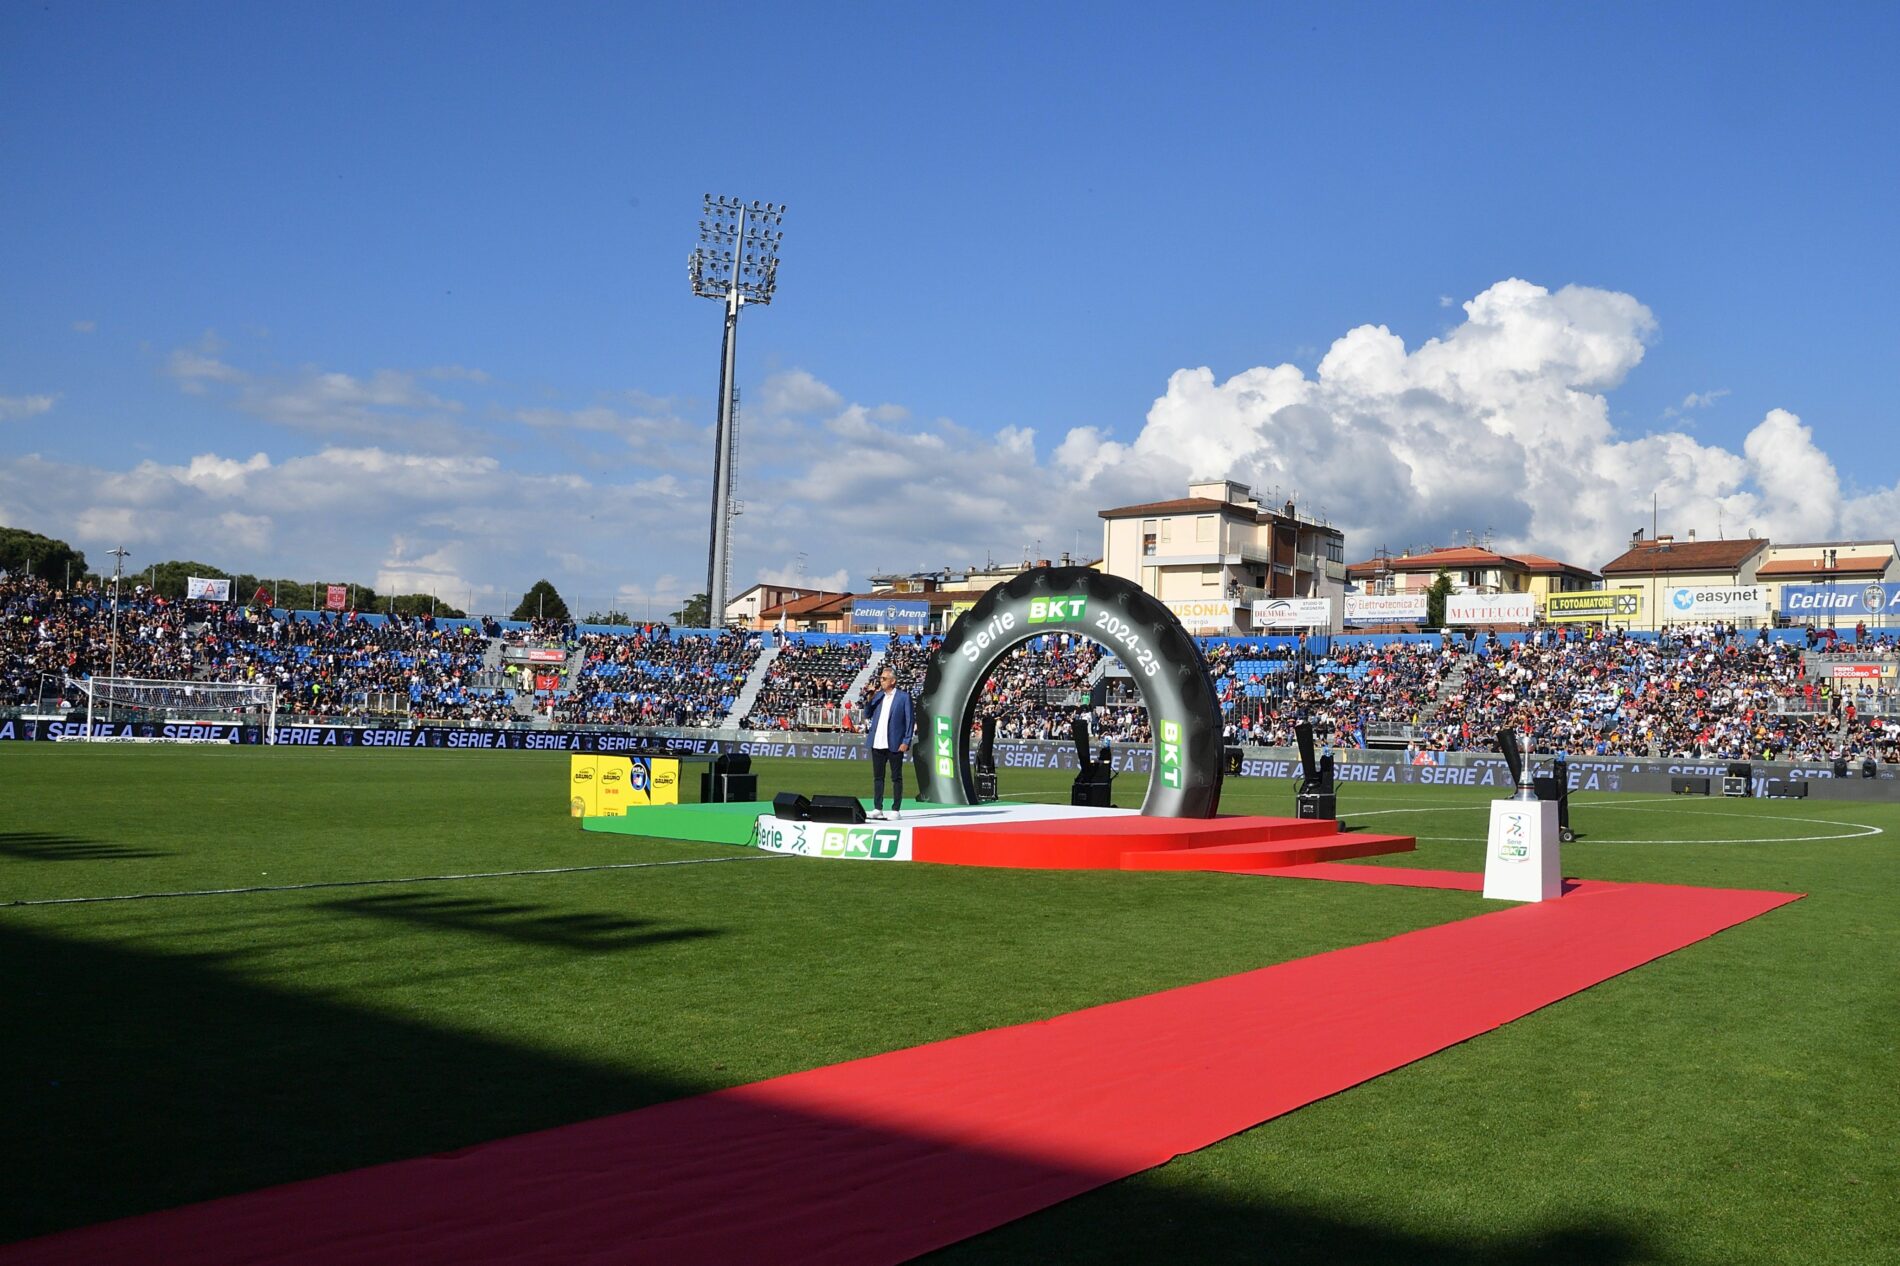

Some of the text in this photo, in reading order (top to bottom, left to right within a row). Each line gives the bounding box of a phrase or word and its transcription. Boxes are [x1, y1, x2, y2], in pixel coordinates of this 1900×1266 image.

[1551, 597, 1614, 610] IL FOTOAMATORE
[1696, 588, 1758, 604] easynet
[1789, 592, 1858, 609] Cetilar
[854, 608, 927, 618] Cetilar Arena
[1029, 598, 1086, 620] BKT
[1172, 603, 1230, 617] USONIA
[1451, 607, 1529, 619] MATTEUCCI
[963, 611, 1016, 662] Serie
[1095, 611, 1160, 677] 2024-25
[227, 727, 240, 744] A
[323, 729, 337, 745] A
[361, 730, 427, 746] SERIE A
[447, 732, 506, 748] SERIE A
[525, 734, 580, 750] SERIE A
[597, 736, 638, 751] SERIE
[708, 741, 719, 754] A
[739, 743, 796, 758] SERIE A
[811, 745, 857, 760] SERIE A
[936, 717, 952, 777] BKT
[1163, 721, 1180, 788] BKT
[1004, 752, 1059, 768] SERIE A
[1124, 757, 1135, 772] A
[1240, 760, 1290, 778] SERIE
[1333, 764, 1396, 782] SERIE A
[1420, 767, 1495, 785] SERIE A
[1584, 773, 1600, 790] A
[822, 828, 901, 858] BKT
